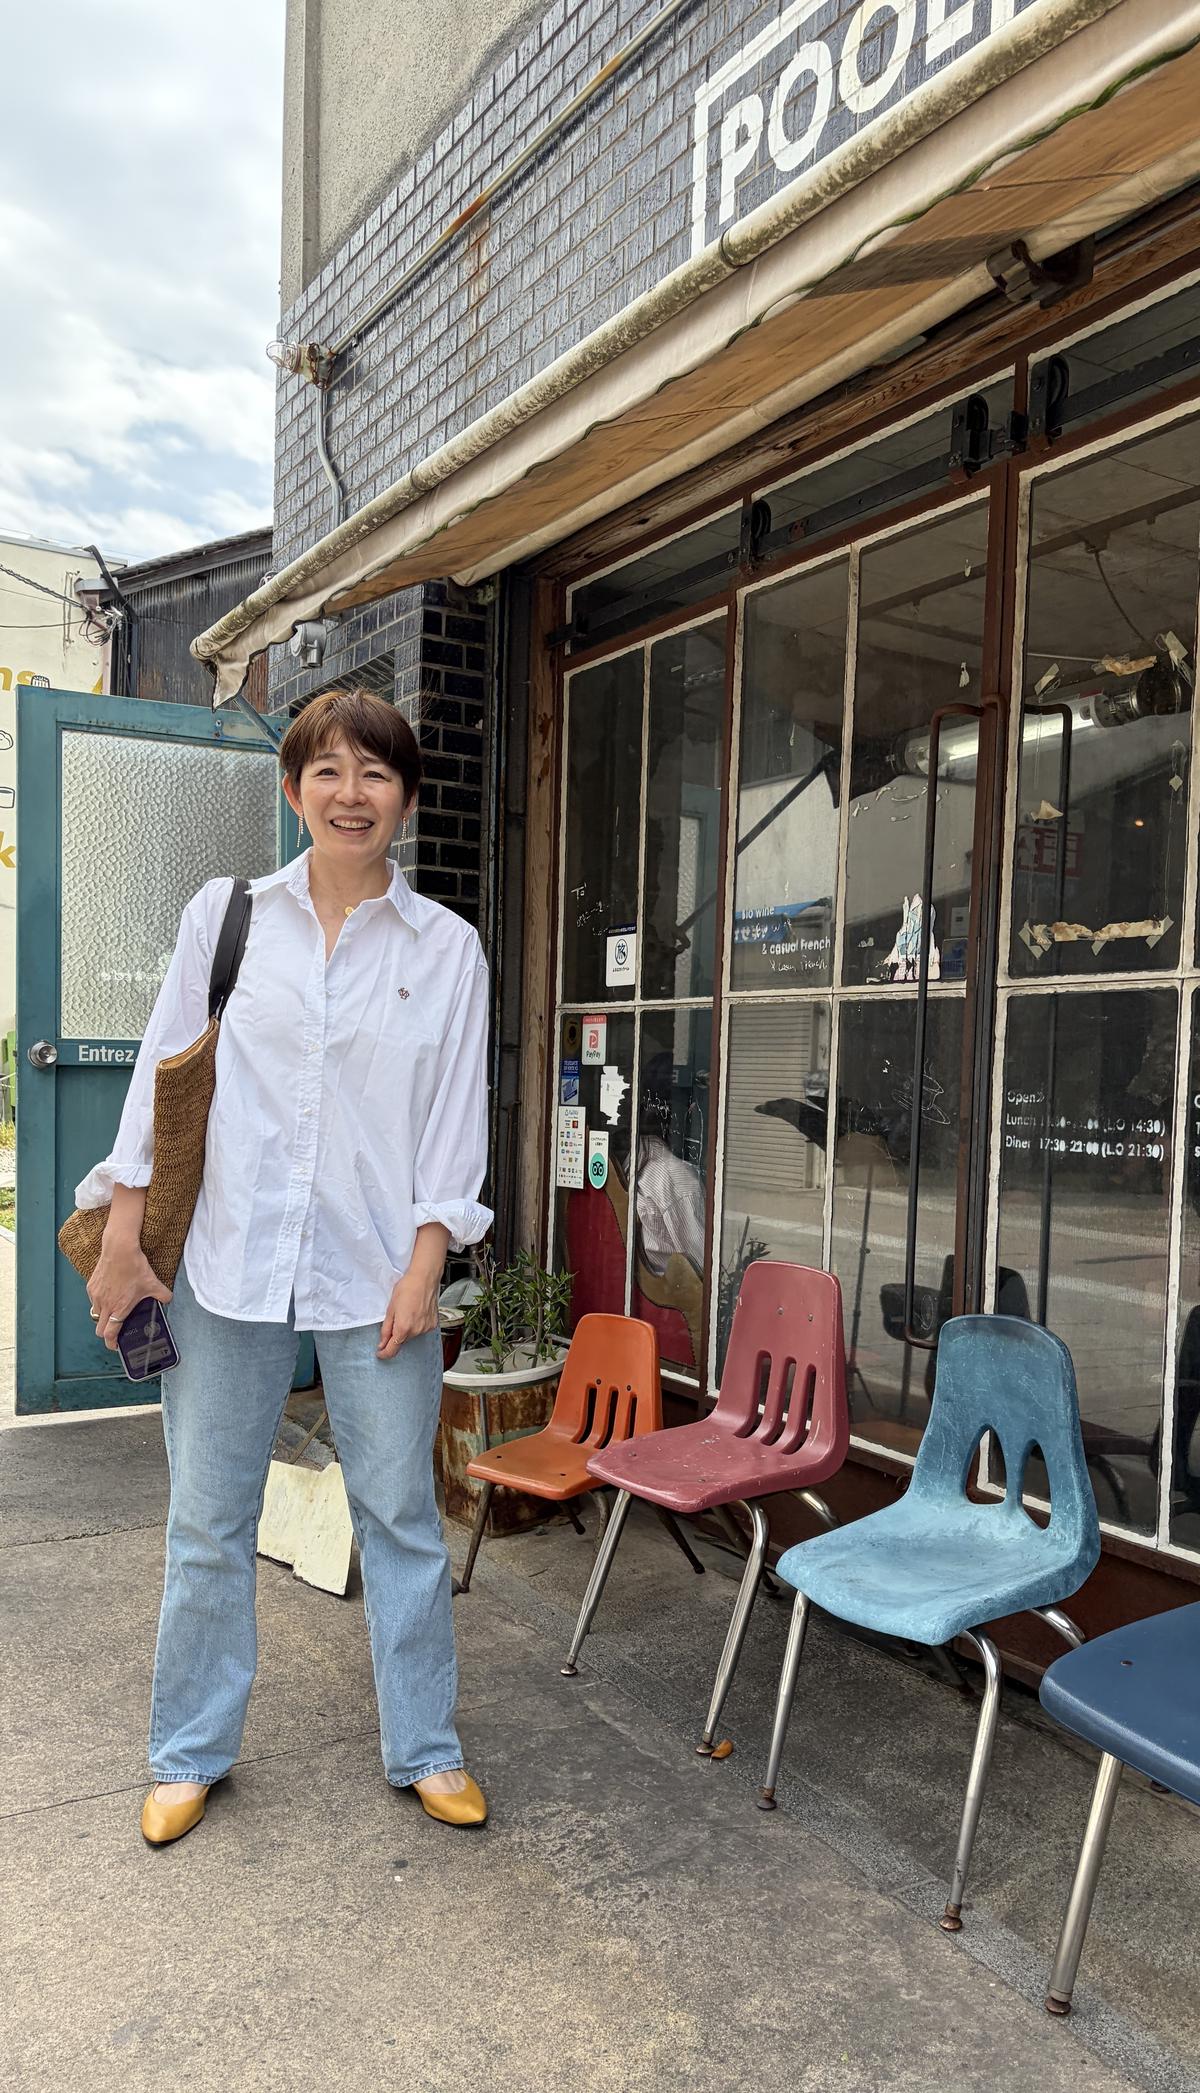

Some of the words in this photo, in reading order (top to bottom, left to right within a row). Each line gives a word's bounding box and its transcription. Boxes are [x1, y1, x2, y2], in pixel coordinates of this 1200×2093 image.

[801, 936, 831, 951] French
[585, 1050, 601, 1059] PayPay
[1127, 1144, 1164, 1161] 21:30)
